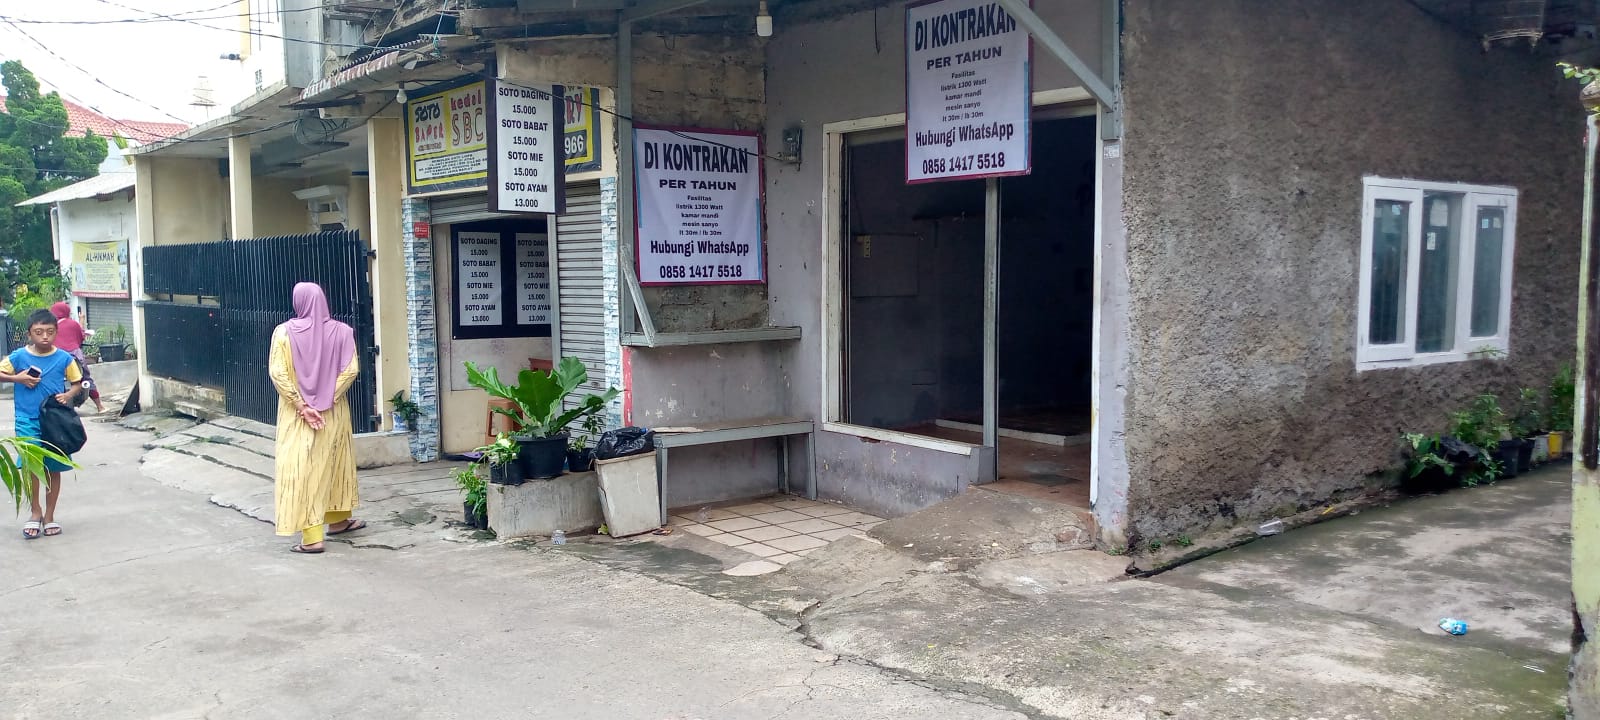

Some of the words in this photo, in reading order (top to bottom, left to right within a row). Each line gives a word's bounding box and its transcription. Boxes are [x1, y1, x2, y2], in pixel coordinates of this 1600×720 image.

[915, 18, 928, 52] DI
[932, 3, 1016, 48] KONTRAKAN
[927, 56, 950, 70] PER
[955, 46, 1002, 65] TAHUN
[952, 70, 976, 79] Fasilitas
[940, 84, 956, 92] listrik
[973, 78, 987, 86] Watt
[499, 87, 519, 97] SOTO
[521, 88, 550, 100] DAGING
[964, 89, 982, 98] mandi
[415, 103, 441, 122] SOTO
[512, 104, 536, 115] 15.000
[452, 108, 484, 146] SBC
[502, 118, 521, 128] SOTO
[524, 121, 548, 131] BABAT
[513, 136, 537, 146] 15.000
[916, 126, 956, 147] Hubungi
[959, 122, 1014, 142] WhatsApp
[508, 151, 528, 160] SOTO
[530, 153, 543, 162] MIE
[644, 142, 658, 169] DI
[663, 143, 748, 173] KONTRAKAN
[922, 158, 946, 174] 0858
[949, 155, 974, 172] 1417
[977, 152, 1005, 170] 5518
[514, 168, 538, 176] 15.000
[505, 182, 525, 191] SOTO
[527, 184, 548, 192] AYAM
[659, 179, 686, 189] PER
[690, 180, 736, 190] TAHUN
[514, 198, 538, 208] 13.000
[650, 240, 694, 257] Hubungi
[697, 241, 749, 256] WhatsApp
[86, 252, 114, 261] AL-HIKMAH
[660, 265, 685, 278] 0858
[689, 265, 714, 278] 1417
[718, 265, 742, 278] 5518
